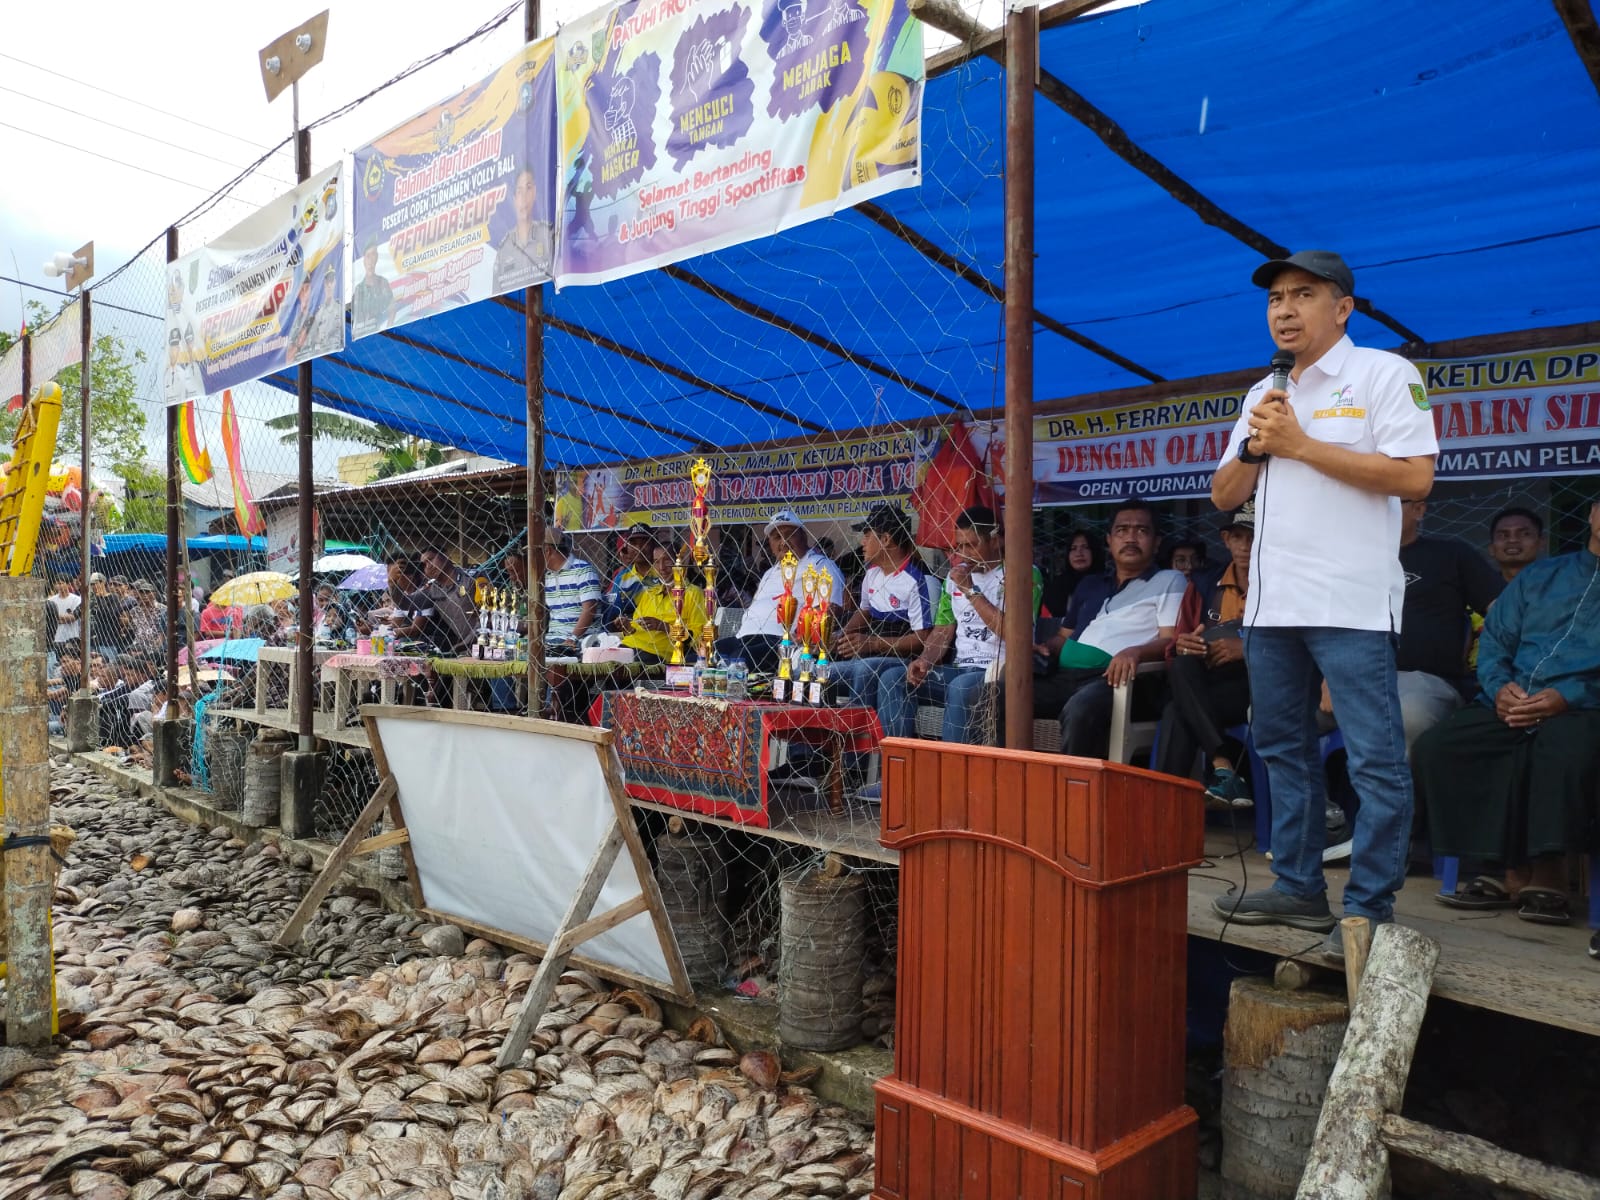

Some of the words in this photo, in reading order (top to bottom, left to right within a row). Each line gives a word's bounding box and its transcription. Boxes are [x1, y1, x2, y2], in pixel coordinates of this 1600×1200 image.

[612, 5, 657, 49] PATUHI
[782, 41, 852, 92] MENJAGA
[798, 72, 831, 101] JARAK
[679, 93, 734, 137] MENCUCI
[688, 120, 724, 146] TANGAN
[394, 162, 438, 206] Selamat
[438, 129, 502, 181] Bertanding
[410, 200, 430, 217] OPEN
[430, 179, 471, 209] TURNAMEN
[471, 163, 496, 189] VOLLY
[497, 154, 515, 178] BALL
[601, 150, 640, 184] MASKER
[638, 179, 690, 210] Selamat
[692, 147, 773, 194] Bertanding
[618, 224, 630, 243] &
[630, 206, 676, 244] Junjung
[678, 191, 723, 221] Tinggi
[724, 163, 807, 209] Sportifitas
[439, 230, 482, 255] PELANGIRAN
[1427, 359, 1537, 390] KETUA
[1546, 352, 1600, 381] DP
[1048, 418, 1084, 438] DR.
[1087, 415, 1111, 435] H.
[802, 443, 846, 466] KETUA
[850, 440, 889, 460] DPRD
[892, 437, 916, 455] KA
[1057, 437, 1157, 474] DENGAN
[1539, 444, 1600, 466] PELA
[634, 480, 716, 506] SUKSESKN
[718, 471, 828, 501] TOURNAMEN
[831, 466, 884, 494] BOLA
[1078, 481, 1125, 498] OPEN
[1126, 475, 1213, 495] TOURNAM
[651, 510, 672, 523] OPEN
[722, 505, 756, 518] PEMUDA
[758, 506, 775, 518] CUP
[777, 501, 835, 517] KECAMATAN
[837, 498, 902, 514] PELANGIRN
